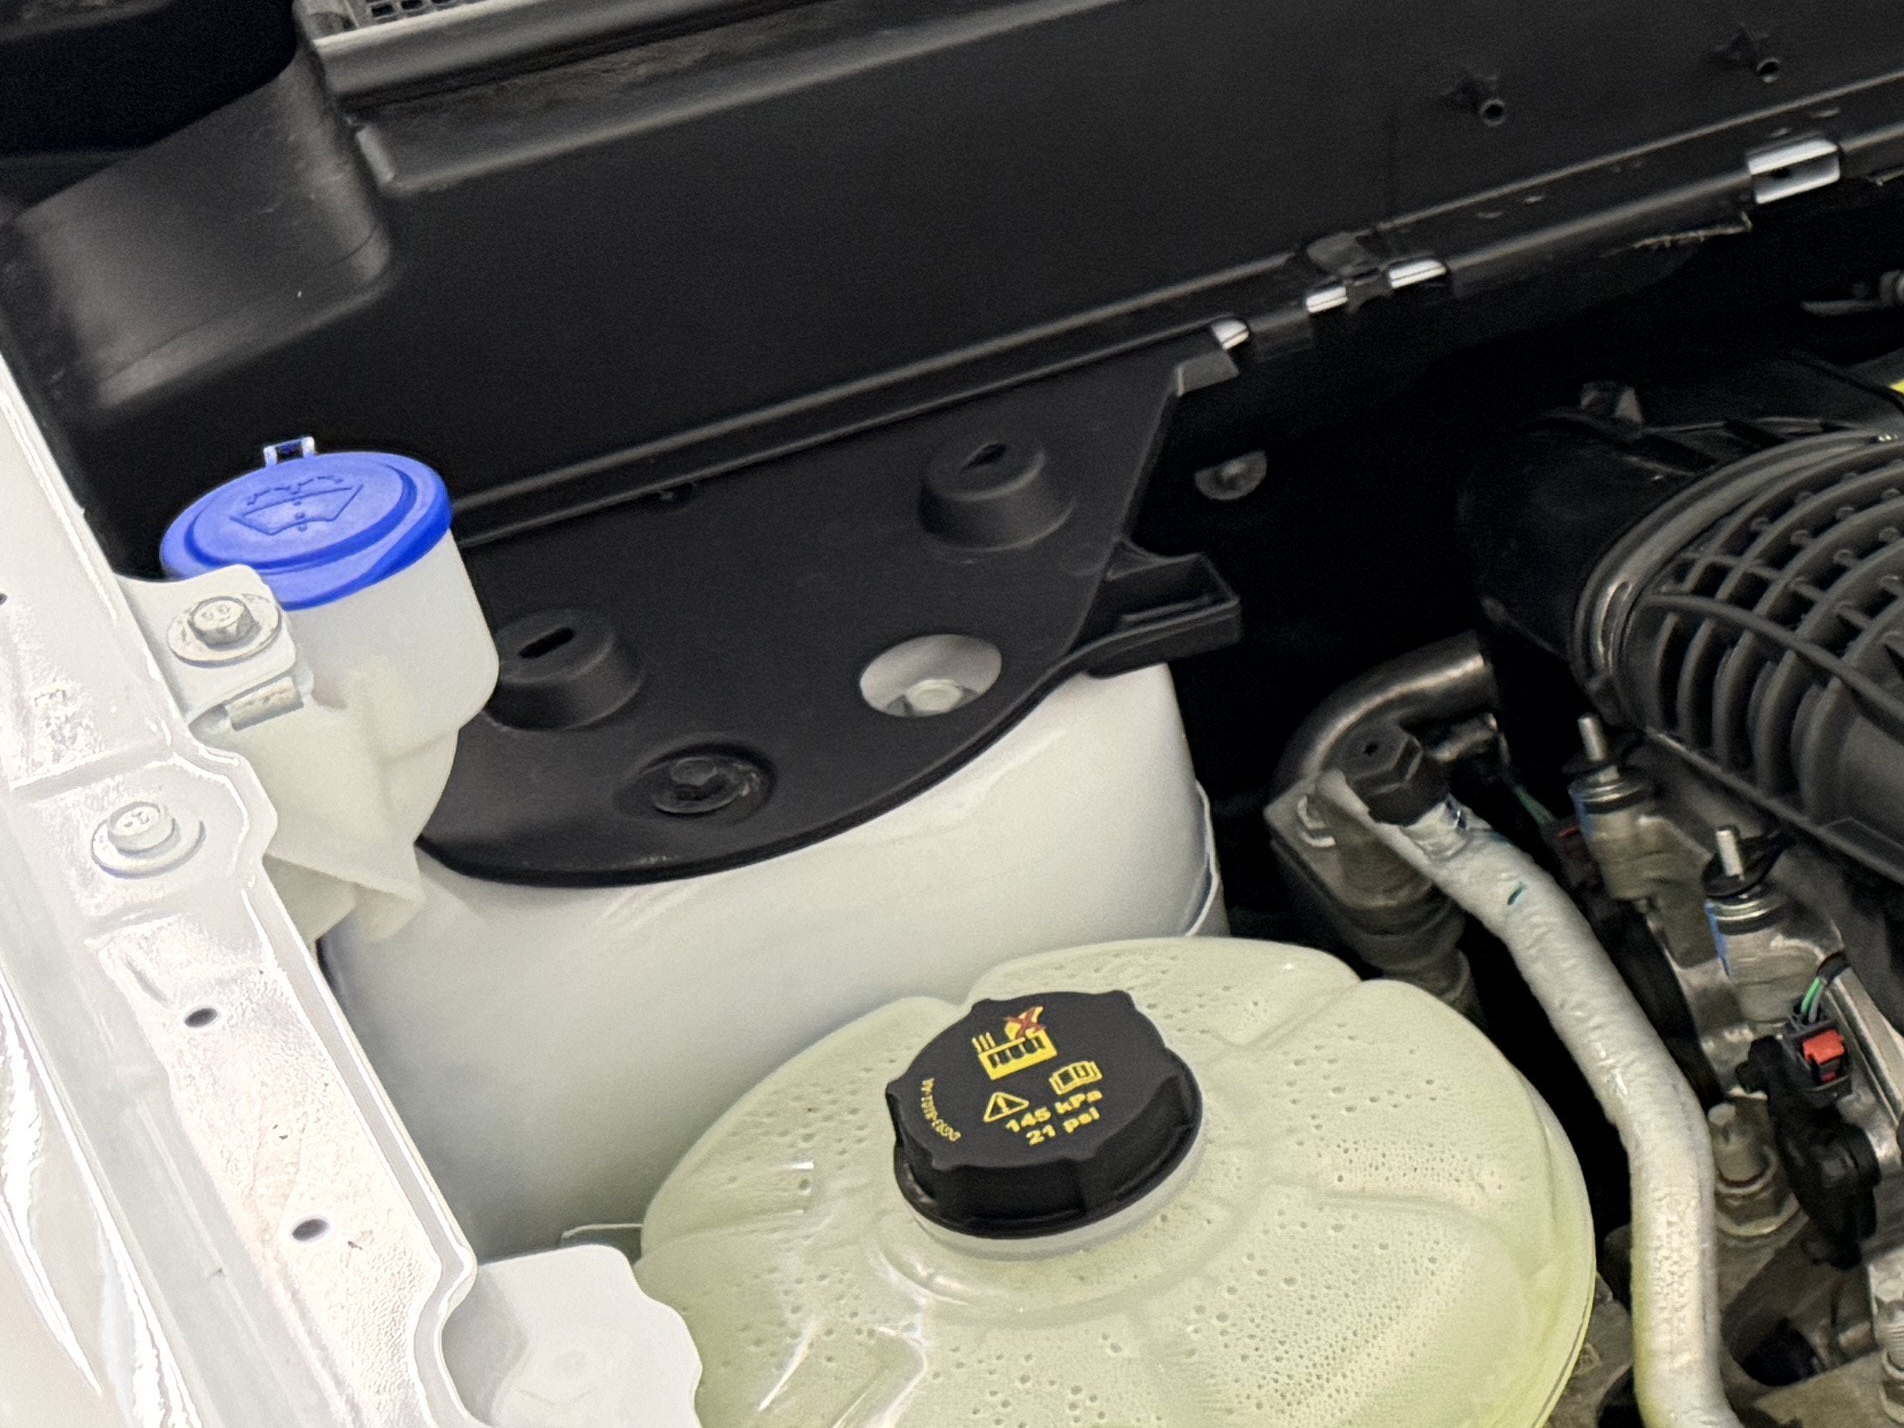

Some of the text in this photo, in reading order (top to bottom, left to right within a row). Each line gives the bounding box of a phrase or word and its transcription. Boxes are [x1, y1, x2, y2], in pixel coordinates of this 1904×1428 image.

[1005, 1089, 1103, 1132] 145 kPa
[1026, 1109, 1101, 1146] 21 psi
